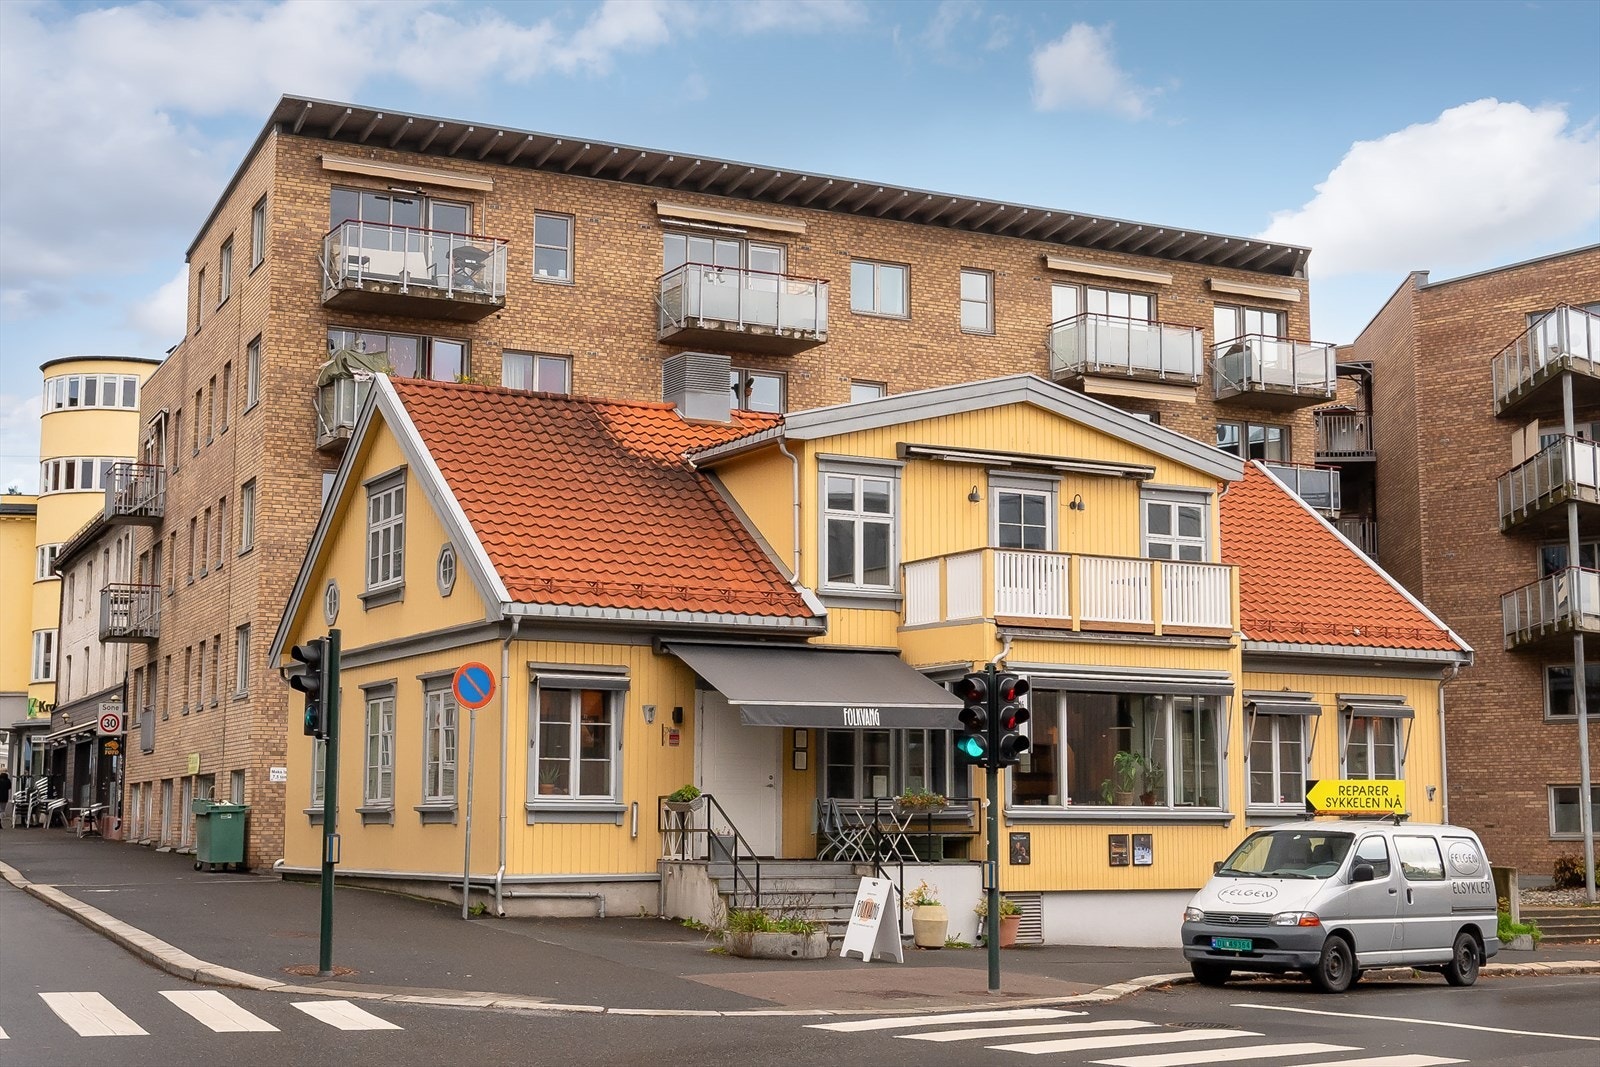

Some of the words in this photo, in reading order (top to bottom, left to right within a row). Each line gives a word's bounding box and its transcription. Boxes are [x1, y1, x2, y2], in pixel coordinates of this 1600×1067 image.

[843, 707, 880, 726] FOLKVANG
[104, 718, 116, 728] 30
[1338, 785, 1389, 796] REPARER
[1325, 797, 1380, 808] SYKKELEN
[1384, 794, 1402, 808] NÅ
[1450, 853, 1478, 864] FELGEN
[1221, 889, 1273, 898] FELGEN
[1452, 881, 1491, 895] ELSYKLER
